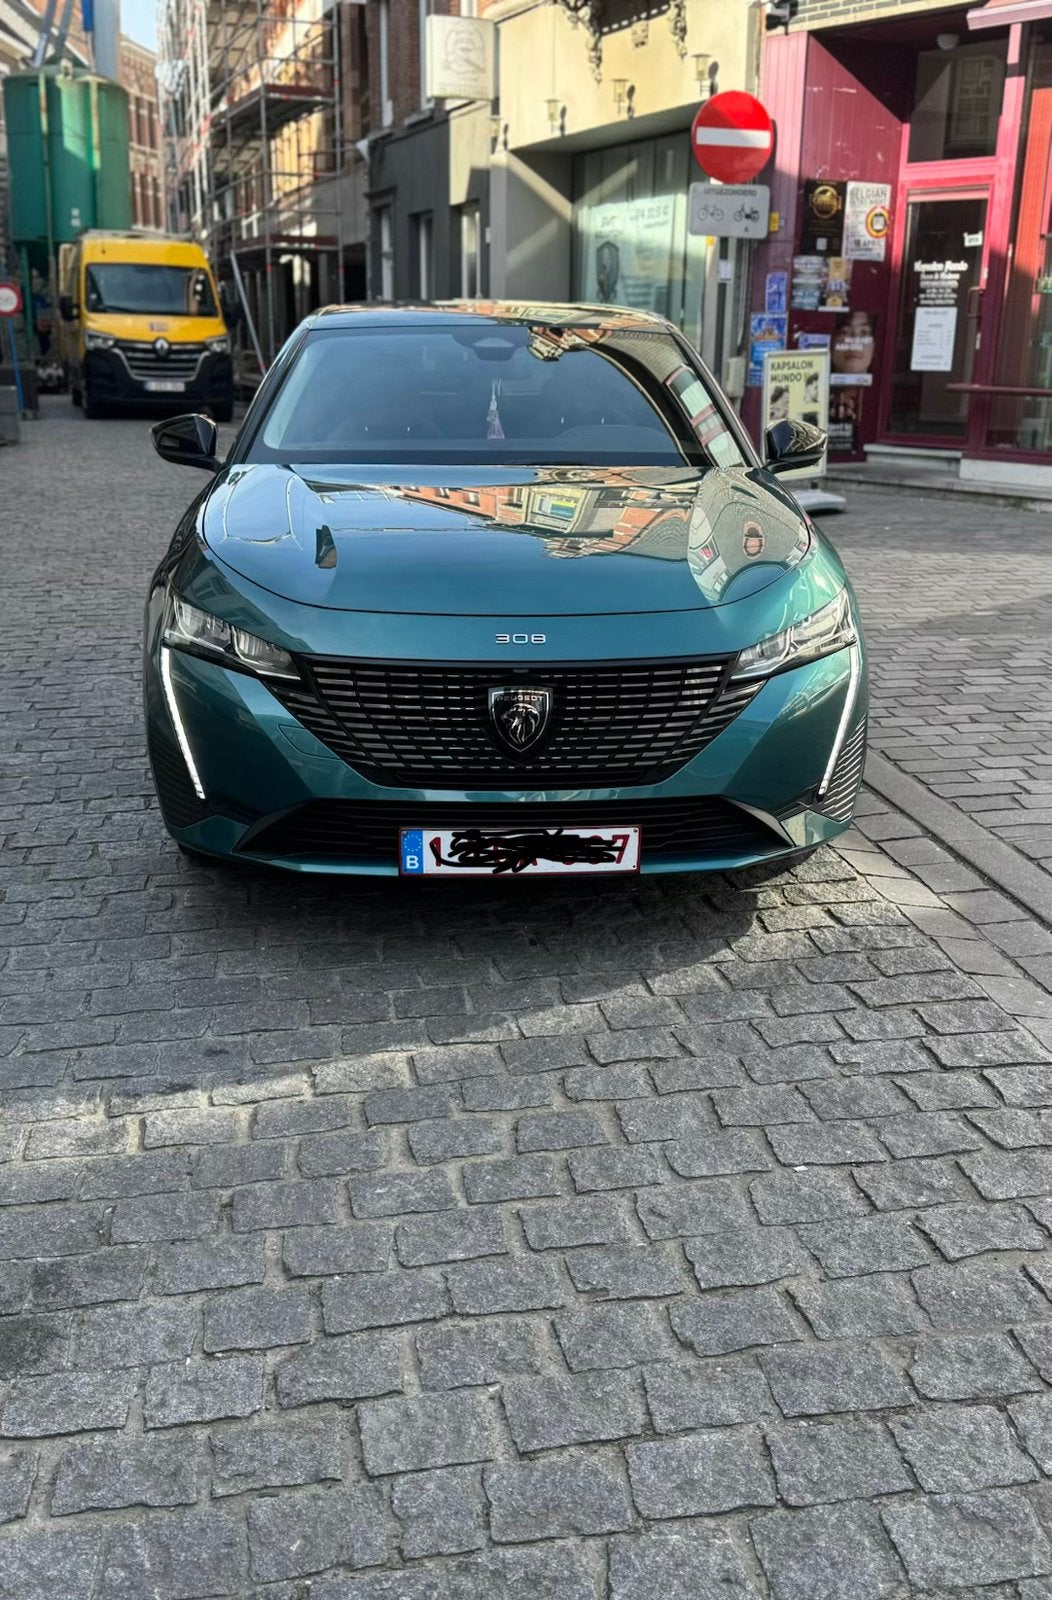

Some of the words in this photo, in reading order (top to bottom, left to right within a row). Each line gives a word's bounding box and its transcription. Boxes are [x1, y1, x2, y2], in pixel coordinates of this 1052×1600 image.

[770, 360, 813, 371] KAPSALON
[770, 373, 802, 383] MUNDO
[495, 633, 547, 644] 308
[496, 694, 544, 702] PEUGEOT
[406, 855, 419, 869] B
